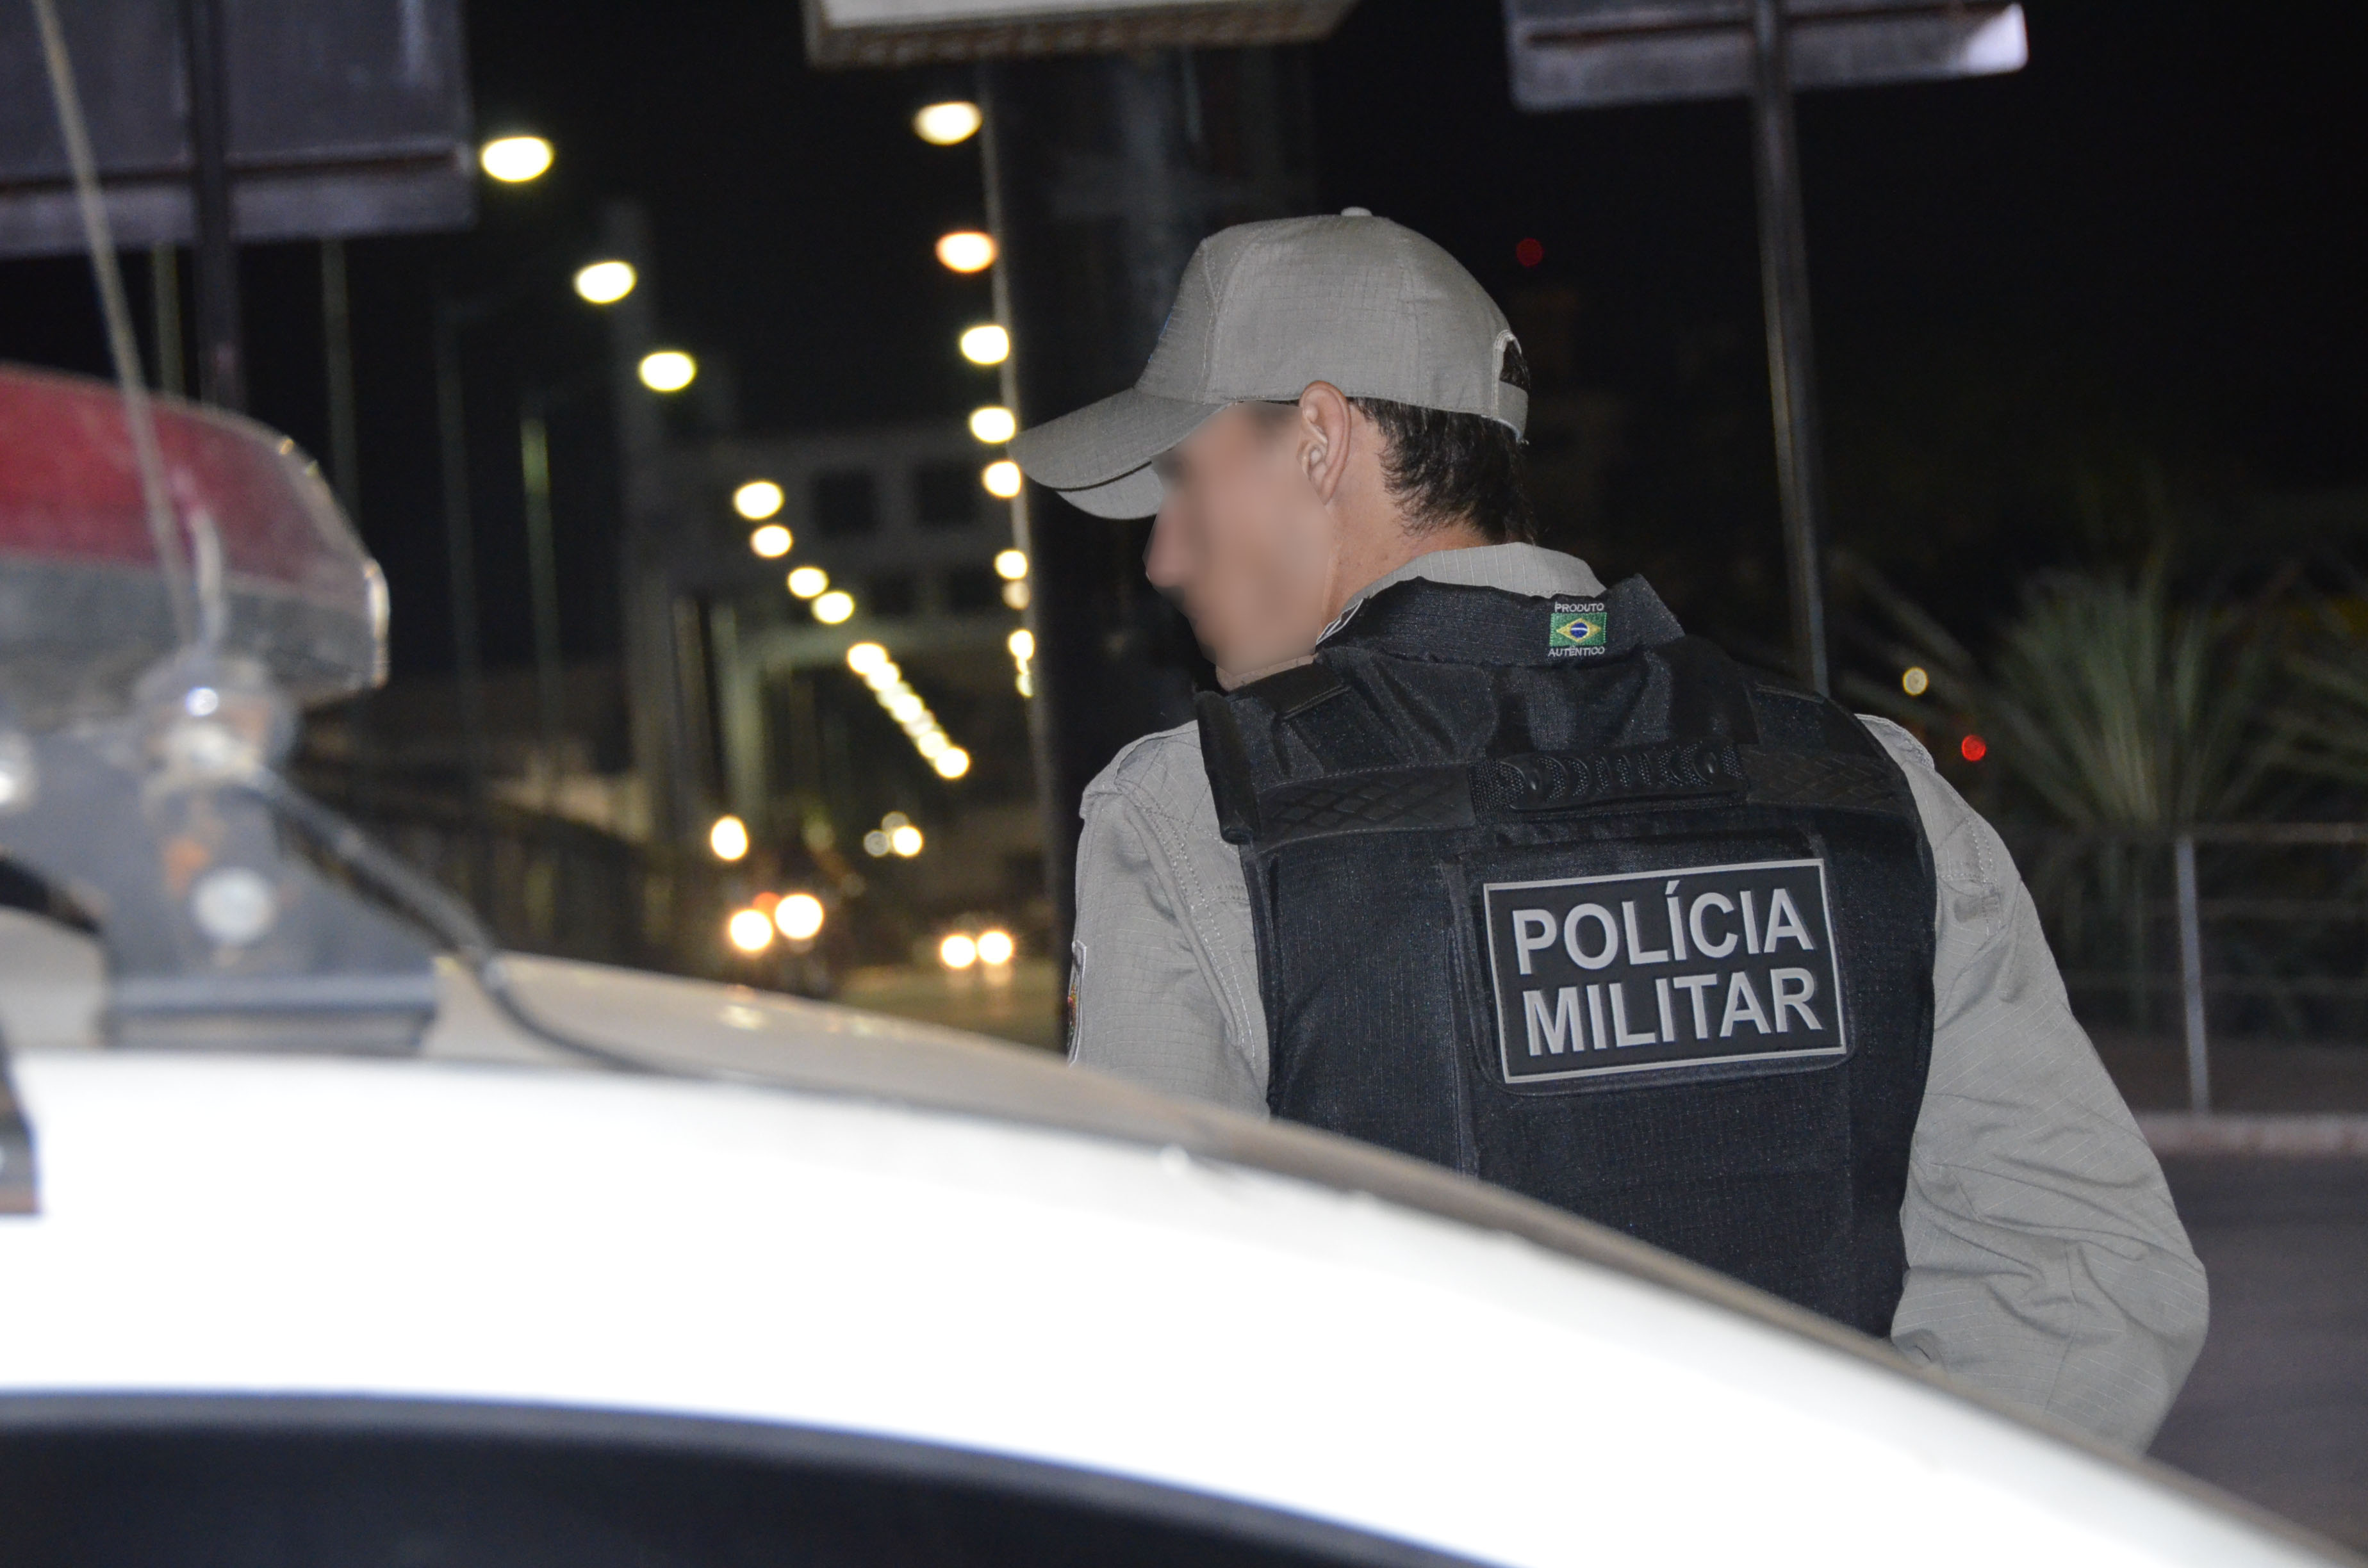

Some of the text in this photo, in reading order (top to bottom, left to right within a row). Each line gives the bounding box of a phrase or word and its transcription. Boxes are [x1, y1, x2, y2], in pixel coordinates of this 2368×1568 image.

[1554, 601, 1604, 612] PRODUTO
[1548, 645, 1605, 657] AUTÊNTICO
[1512, 879, 1814, 975] POLÍCIA
[1522, 967, 1823, 1056] MILITAR
